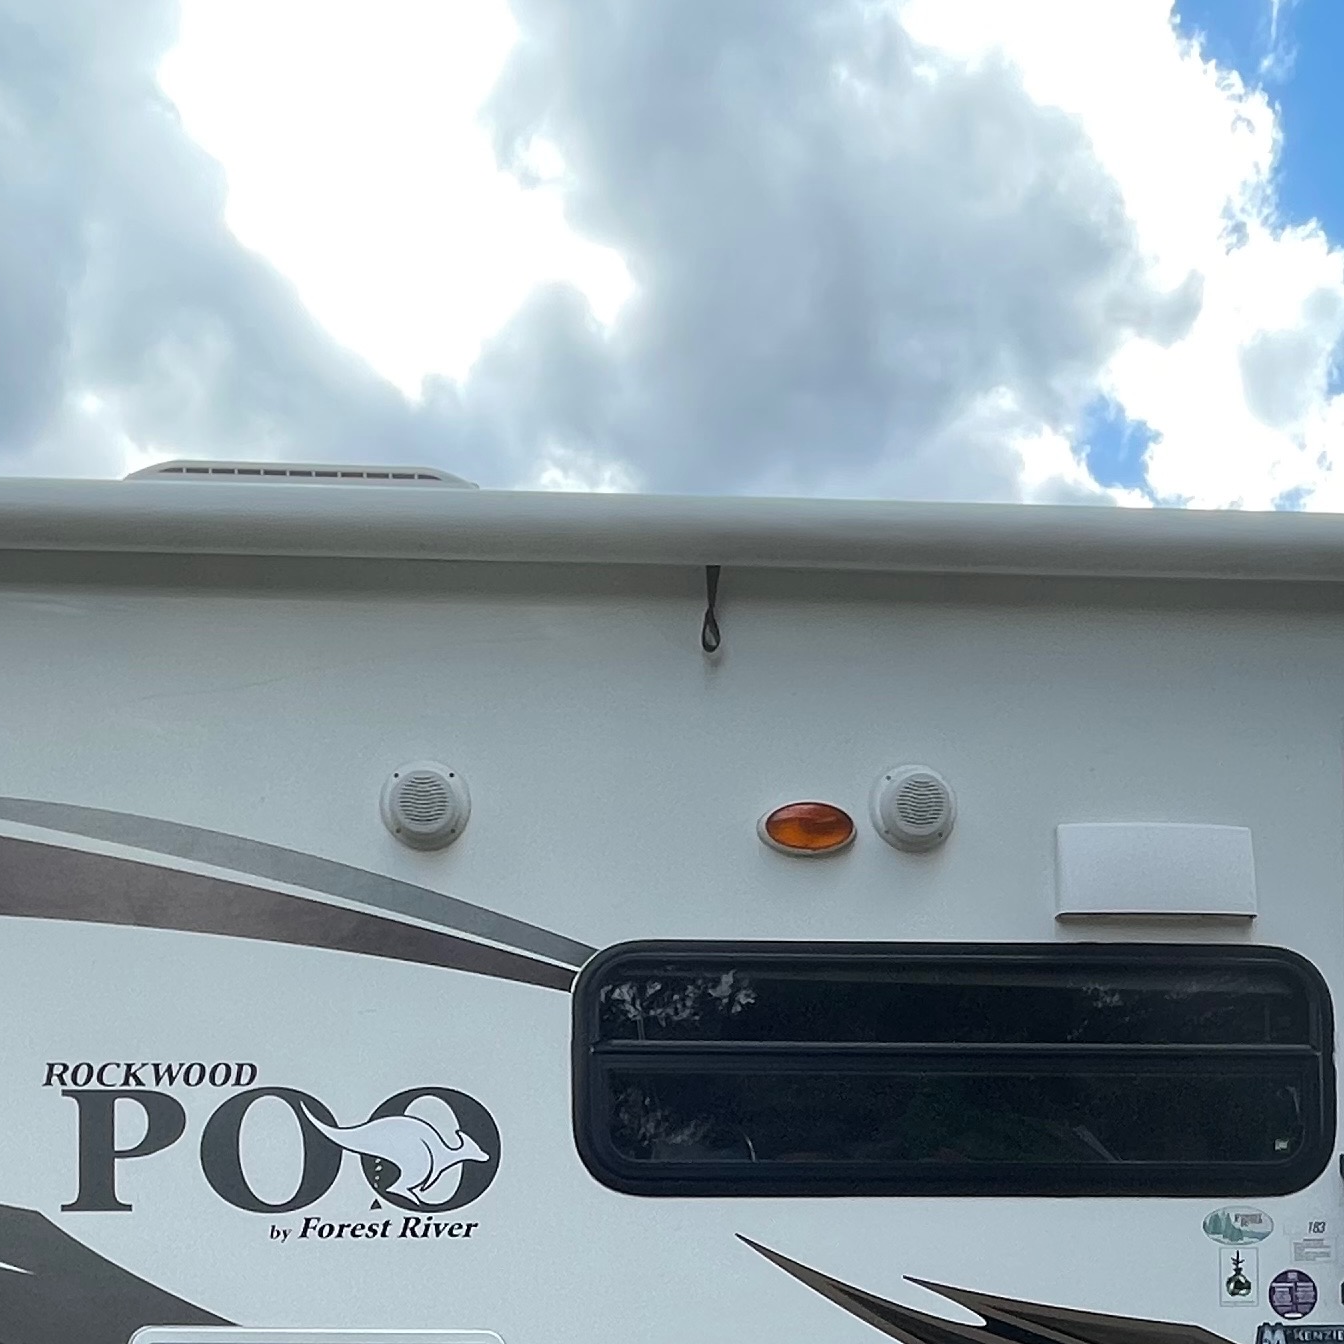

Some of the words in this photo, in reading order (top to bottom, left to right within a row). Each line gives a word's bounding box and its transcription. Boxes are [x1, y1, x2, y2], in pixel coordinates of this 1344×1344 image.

[42, 1062, 258, 1087] ROCKWOOD
[270, 1225, 291, 1243] by
[298, 1216, 392, 1239] Forest
[398, 1215, 479, 1239] River
